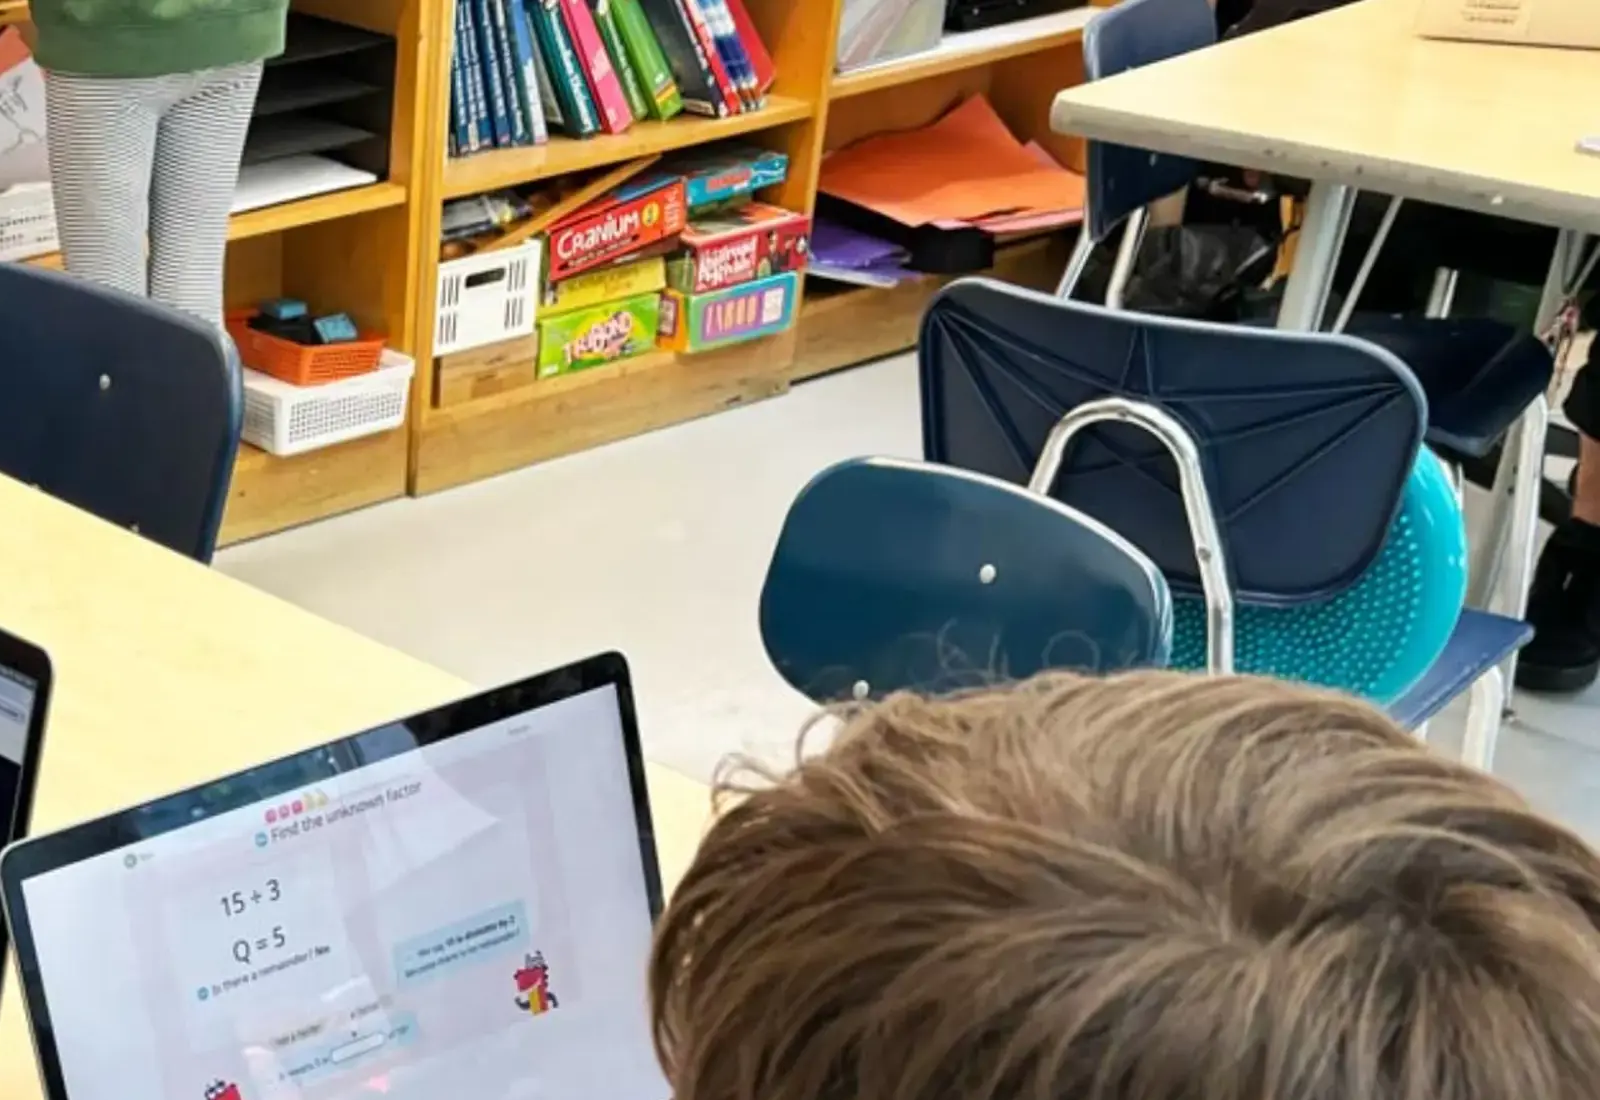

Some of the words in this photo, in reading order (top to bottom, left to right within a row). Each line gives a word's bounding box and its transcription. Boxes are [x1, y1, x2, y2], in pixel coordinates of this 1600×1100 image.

[270, 822, 298, 843] Find
[301, 813, 324, 833] the
[325, 793, 384, 824] unknown
[386, 781, 422, 804] factor
[220, 891, 246, 917] 15
[266, 879, 281, 901] 3
[232, 939, 251, 964] Q
[272, 926, 286, 948] 5
